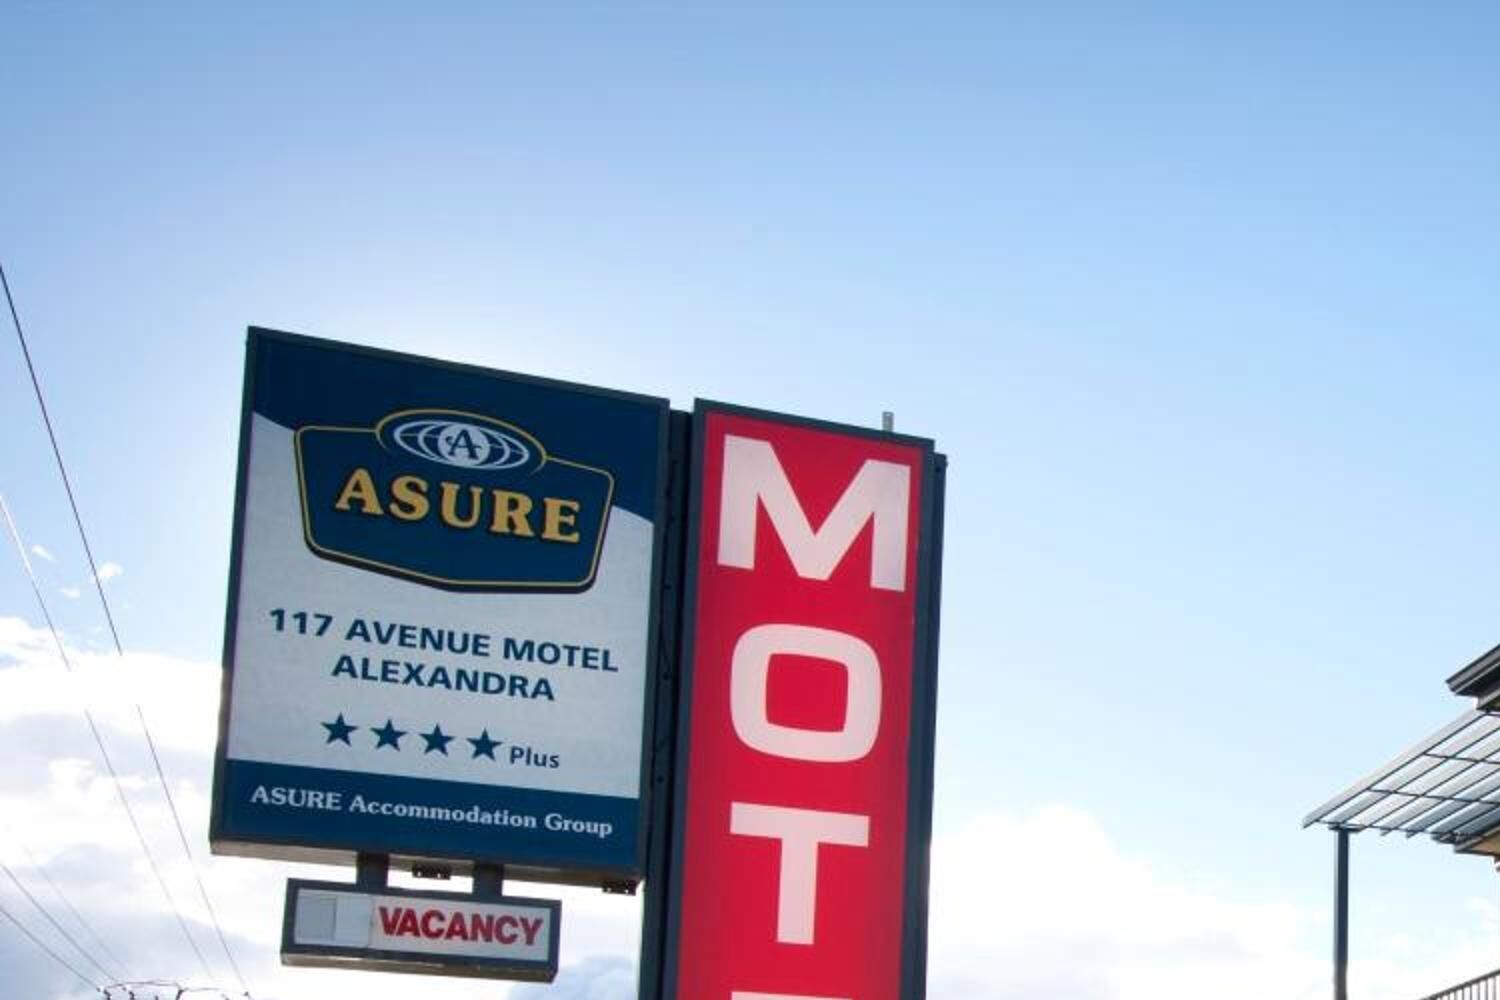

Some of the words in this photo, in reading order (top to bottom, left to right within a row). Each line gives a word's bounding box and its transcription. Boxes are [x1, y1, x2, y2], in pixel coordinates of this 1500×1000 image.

[336, 469, 580, 542] ASURE
[269, 609, 334, 636] 117
[345, 619, 491, 656] AVENUE
[503, 638, 619, 672] MOTEL
[332, 656, 555, 700] ALEXANDRA
[510, 746, 560, 768] Plus
[251, 786, 342, 811] ASURE
[350, 796, 537, 829] Accommodation
[545, 813, 613, 837] Group
[379, 907, 544, 946] VACANCY
